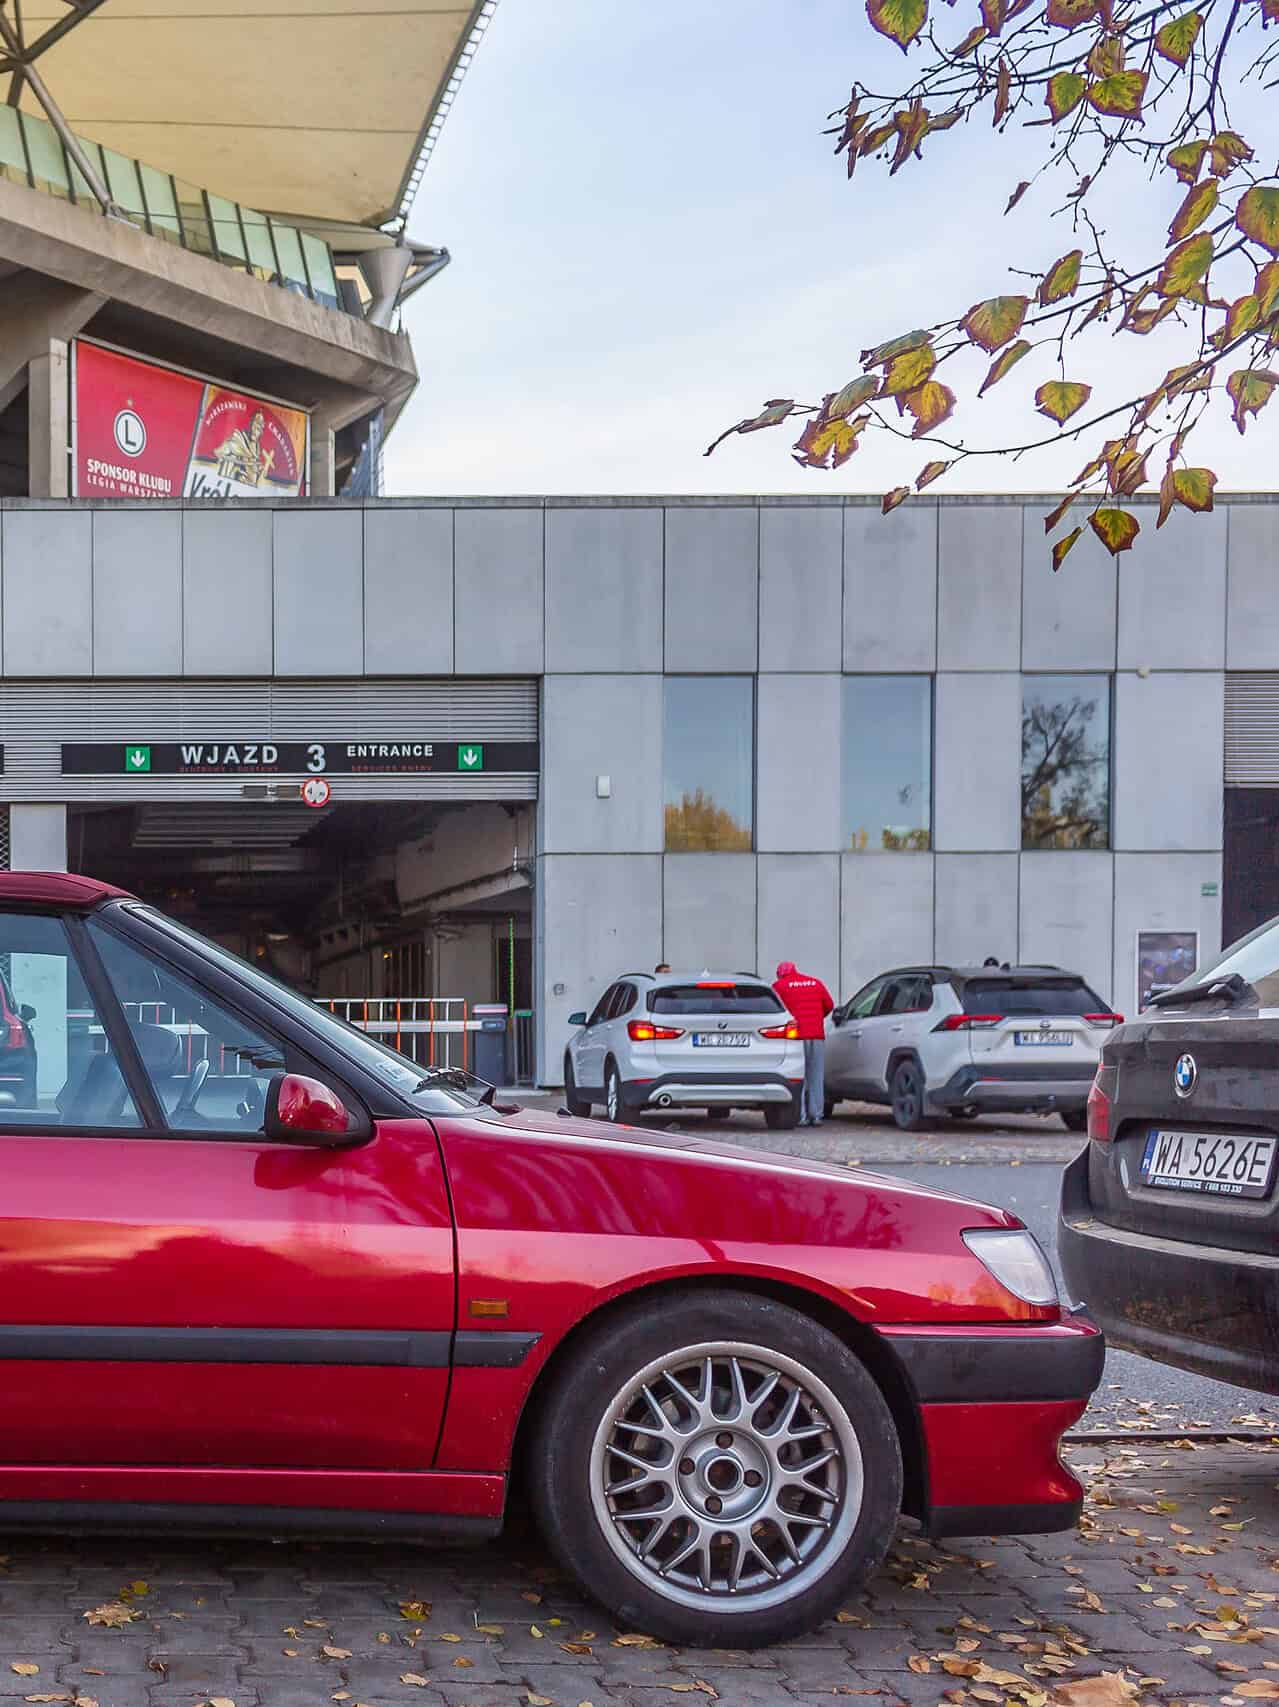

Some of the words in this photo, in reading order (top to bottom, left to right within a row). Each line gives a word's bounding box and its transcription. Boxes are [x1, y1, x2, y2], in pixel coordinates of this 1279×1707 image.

[125, 419, 137, 447] L
[87, 458, 137, 484] SPONSOR
[139, 472, 171, 493] KLUBU
[87, 474, 116, 490] LEGIA
[181, 745, 278, 764] WJAZD
[306, 744, 327, 773] 3
[347, 744, 433, 757] ENTRANCE
[1154, 1135, 1184, 1175] WA
[1189, 1137, 1271, 1183] 5626E
